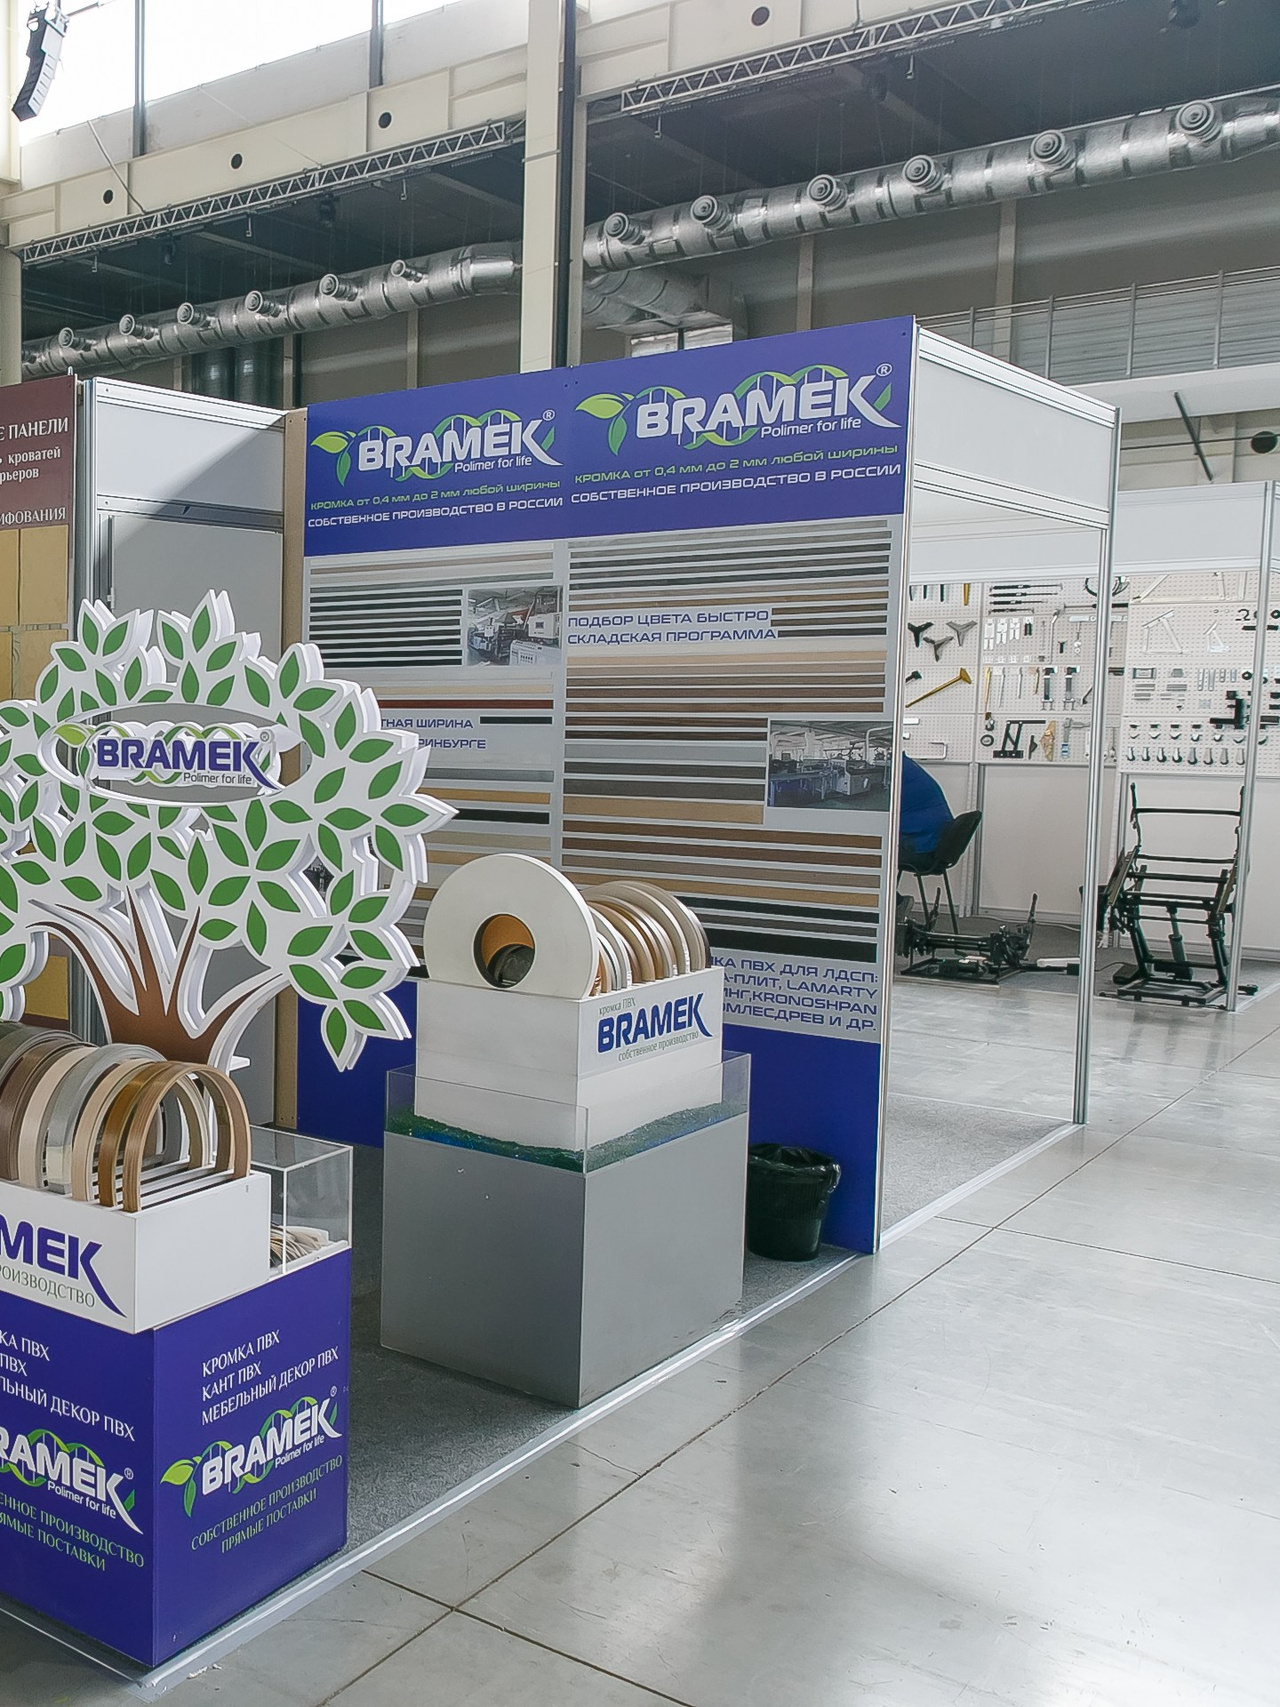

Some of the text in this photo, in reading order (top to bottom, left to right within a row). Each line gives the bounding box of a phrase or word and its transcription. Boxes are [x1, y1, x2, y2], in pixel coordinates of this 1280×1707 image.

[637, 375, 902, 438] BRAMEK
[8, 417, 68, 440] ПАНЕЛИ
[761, 418, 862, 438] Polimer for life
[8, 446, 61, 466] кроватей
[358, 420, 563, 471] BRAMEK
[454, 457, 532, 472] Polimer for life
[575, 471, 630, 484] КРОМКА
[654, 466, 676, 477] 0,4
[730, 460, 738, 468] 2
[770, 450, 824, 465] любой
[827, 445, 898, 460] ширины
[311, 500, 354, 510] КРОМКА
[372, 495, 390, 506] 0,4
[430, 491, 438, 499] 2
[462, 484, 504, 496] любой
[506, 480, 560, 492] ширины
[571, 464, 901, 503] СОБСТВЕННОЕ ПРОИЗВОДСТВО В РОССИИ
[308, 498, 563, 528] СОБСТВЕННОЕ ПРОИЗВОДСТВО В РОССИИ
[568, 611, 768, 628] ПОДБОР ЦВЕТА БЫСТРО
[568, 630, 776, 646] СКЛАДСКАЯ ПРОГРАММА
[416, 719, 473, 728] ШИРИНА
[97, 738, 280, 790] BRAMEK
[184, 772, 252, 784] Polimer for life
[741, 960, 776, 972] ПВХ
[780, 964, 818, 977] ДЛЯ
[823, 969, 878, 982] ЛДСП:
[787, 980, 878, 998] LAMARTY
[598, 992, 713, 1054] BRAMEK
[830, 1016, 841, 1026] И
[846, 1018, 876, 1031] ДР.
[618, 1031, 698, 1062] собственное производство
[0, 1353, 28, 1376] ПВХ
[22, 1338, 50, 1362] ПВХ
[202, 1330, 280, 1378] КРОМКА ПВХ
[202, 1361, 262, 1402] КАНТ ПВХ
[202, 1346, 338, 1426] МЕБЕЛЬНЫЙ ДЕКОР ПВХ
[50, 1396, 100, 1426] ДЕКОР
[104, 1416, 135, 1442] ПВХ
[202, 1398, 342, 1496] BRAMEK
[275, 1434, 324, 1468] Polimer for life
[48, 1480, 116, 1518] Polimer for life
[191, 1454, 342, 1550] СОБСТВЕННОЕ ПРОИЗВОДСТВО
[222, 1488, 317, 1554] ПРЯМЫЕ ПОСТАВКИ
[38, 1529, 105, 1571] ПОСТАВКИ
[40, 1510, 144, 1568] ПРОИЗВОДСТВО
